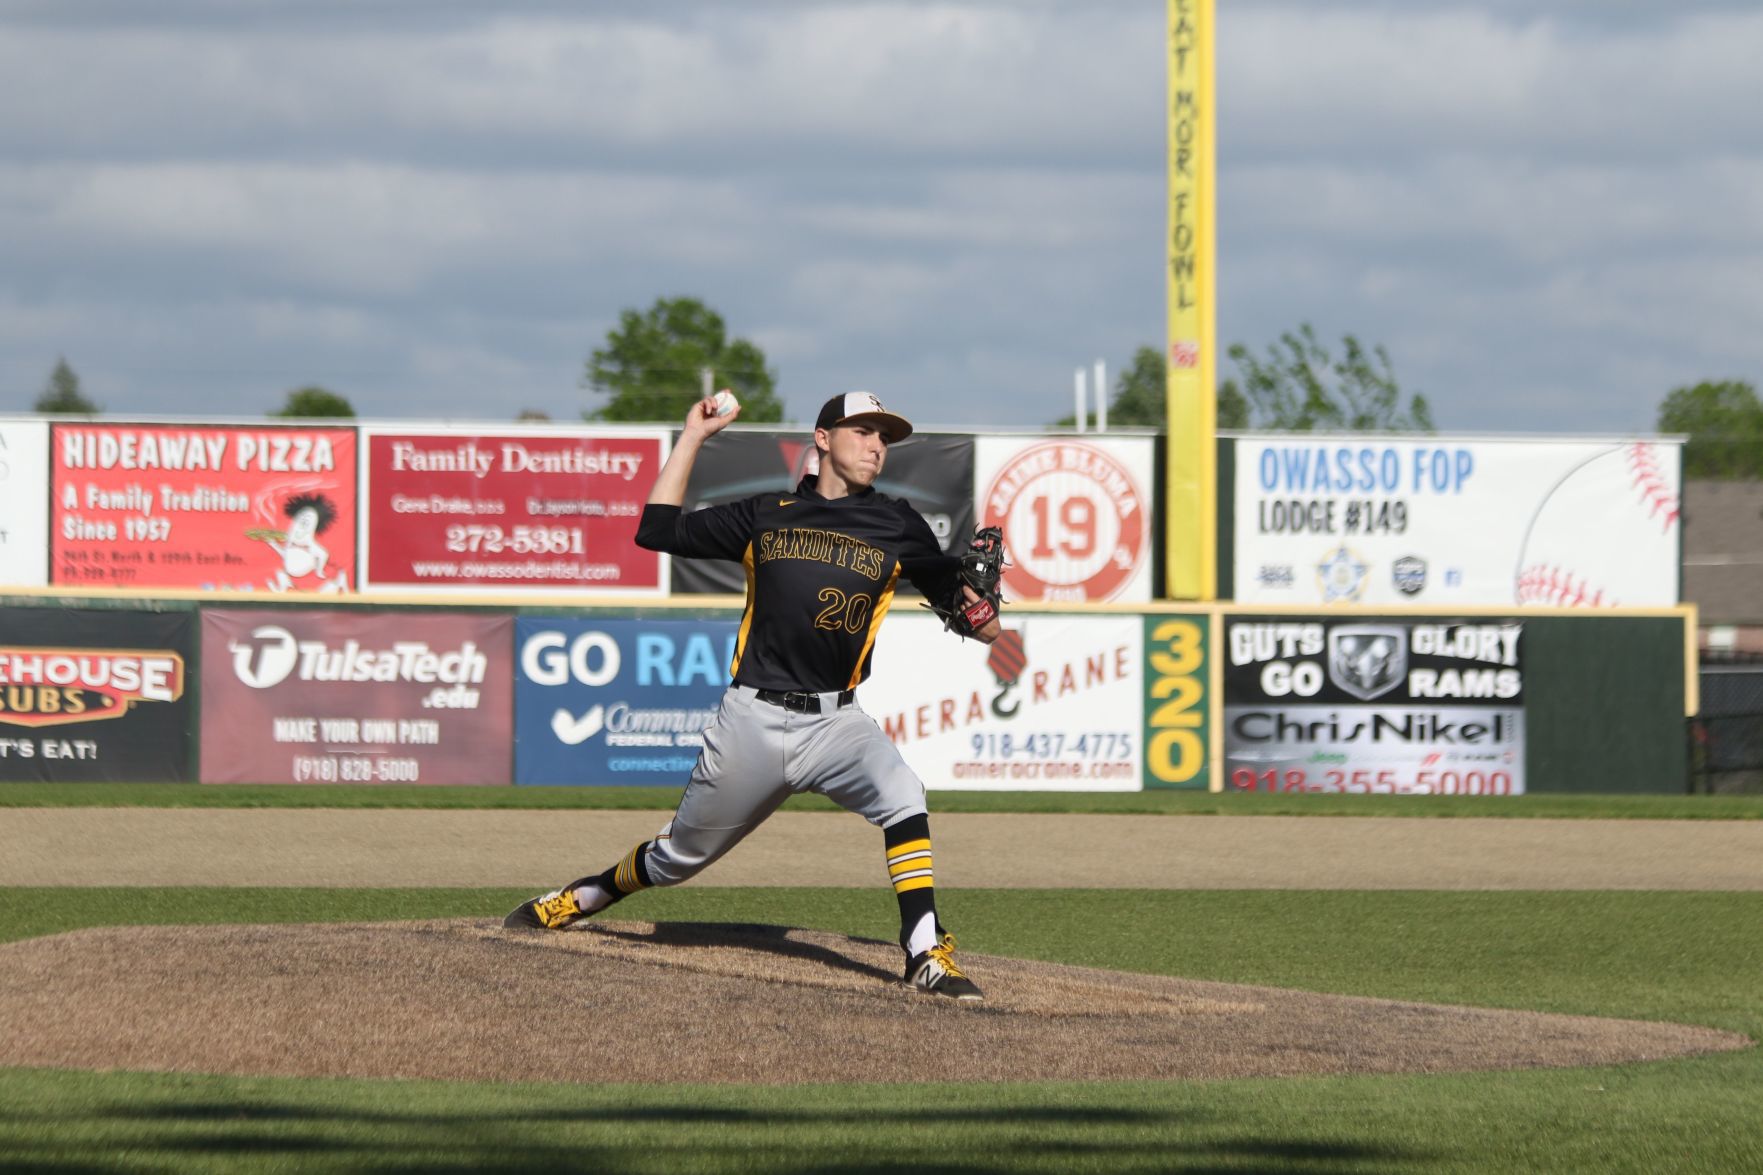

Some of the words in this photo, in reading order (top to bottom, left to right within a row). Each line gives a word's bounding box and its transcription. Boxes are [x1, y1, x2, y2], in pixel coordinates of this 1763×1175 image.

[1174, 192, 1195, 311] FOWL
[62, 431, 228, 471] HIDEAWAY
[237, 435, 335, 473] PIZZA
[391, 442, 494, 478] Family
[501, 444, 643, 481] Dentistry
[1061, 447, 1138, 519] BLUMA
[1259, 448, 1401, 493] OWASSO
[1412, 448, 1474, 493] FOP
[63, 484, 78, 510] A
[87, 485, 154, 516] Family
[159, 486, 250, 512] Tradition
[1258, 499, 1337, 534] LODGE
[1344, 500, 1409, 535] #149
[63, 515, 117, 541] Since
[124, 517, 172, 542] 1957
[446, 524, 584, 554] 272-5381
[1031, 496, 1097, 560] 19
[412, 559, 621, 581] www.owassodentist.com
[760, 528, 885, 581] SANDITES
[815, 587, 872, 634] 20
[299, 639, 488, 684] TulsaTech
[521, 630, 621, 687] GO
[635, 632, 737, 687] RA
[1229, 623, 1325, 667] GUTS
[1411, 624, 1523, 667] GLORY
[422, 684, 480, 709] .edu
[1260, 661, 1325, 697] GO
[1408, 668, 1523, 698] RAMS
[1147, 619, 1205, 783] 320
[273, 718, 318, 743] MAKE
[320, 718, 360, 743] YOUR
[361, 719, 397, 743] OWN
[399, 719, 440, 744] PATH
[605, 732, 673, 747] FEDERAL
[971, 732, 1132, 760] 918-437-4775
[1232, 712, 1503, 745] ChrisNikel
[42, 739, 98, 760] EAT!
[293, 755, 338, 782] (918)
[952, 762, 1134, 781] ameracrane.com
[1230, 766, 1513, 795] 918-355-5000
